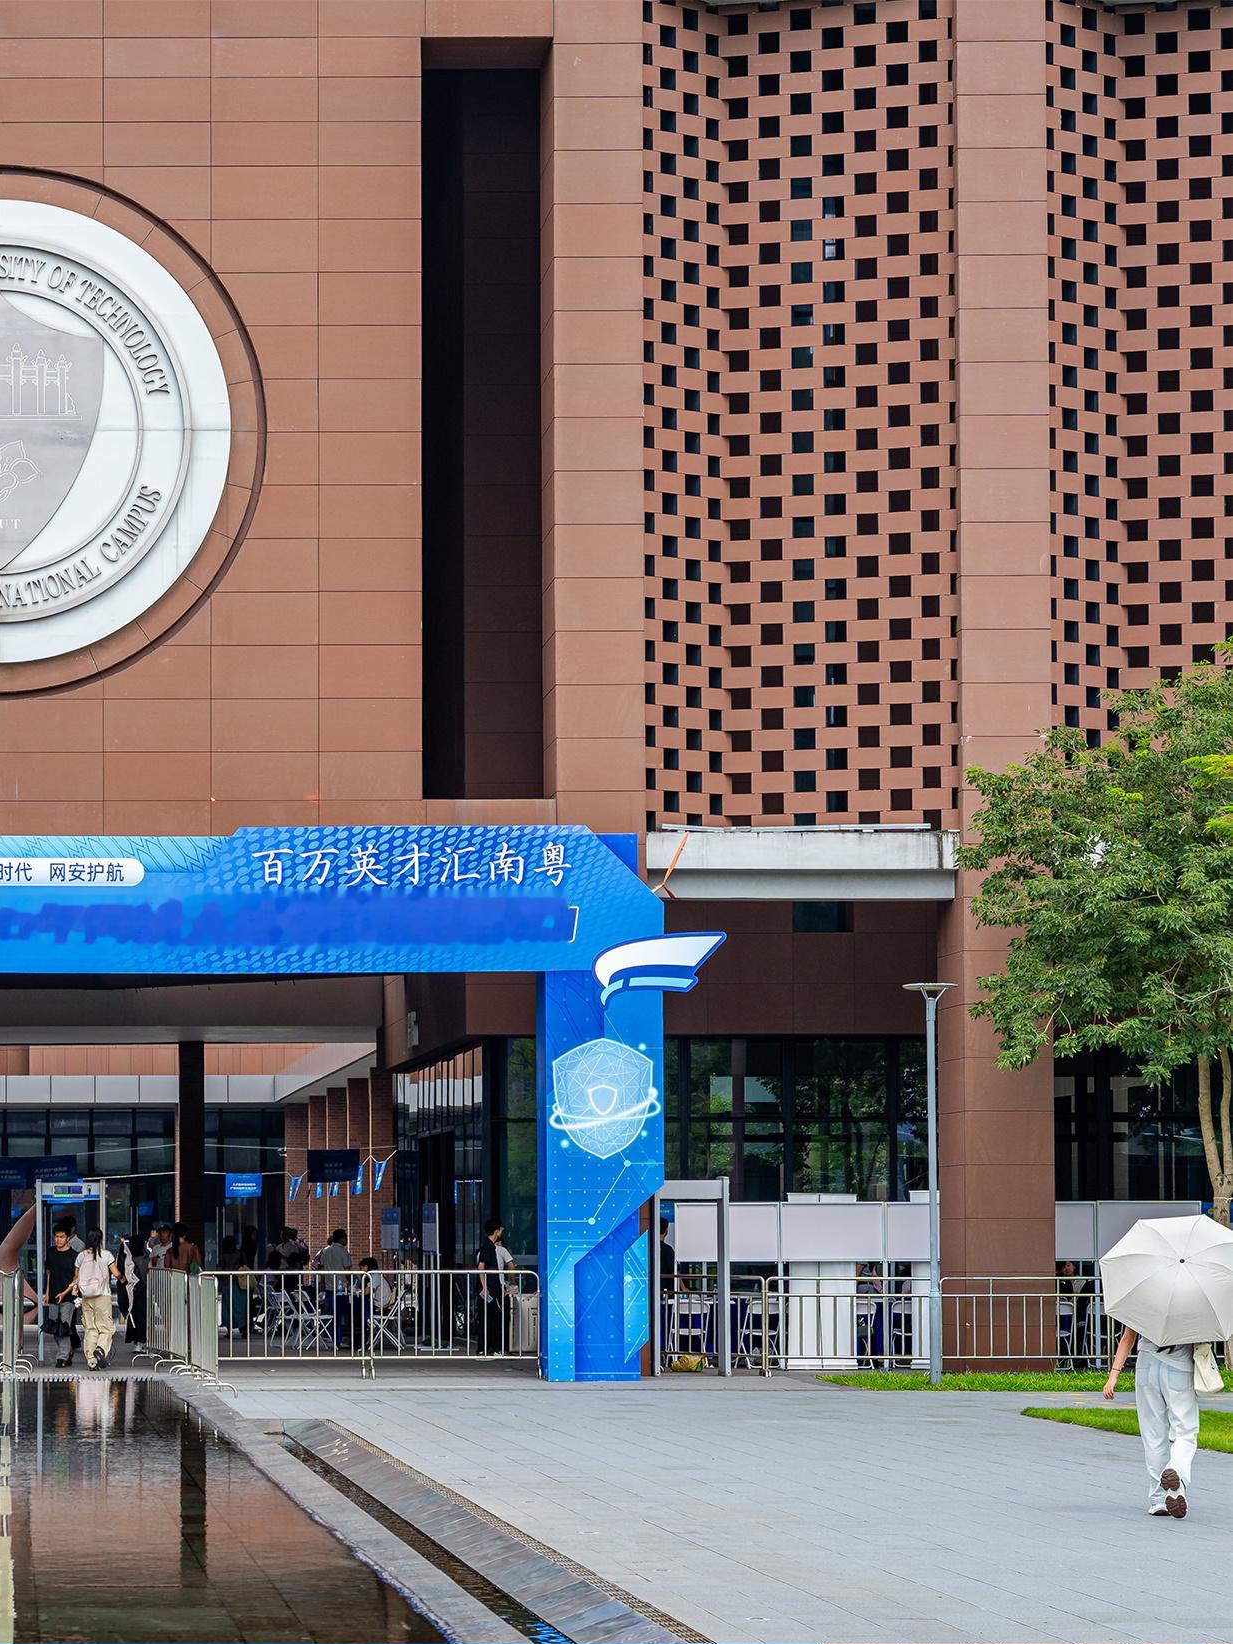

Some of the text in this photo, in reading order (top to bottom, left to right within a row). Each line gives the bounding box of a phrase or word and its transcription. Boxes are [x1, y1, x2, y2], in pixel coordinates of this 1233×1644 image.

[47, 265, 78, 293] OF
[75, 279, 170, 395] TECHNOLOGY
[99, 484, 163, 563] CAMPUS
[49, 863, 125, 882] 网安护航
[251, 841, 572, 887] 百万英才汇南粤
